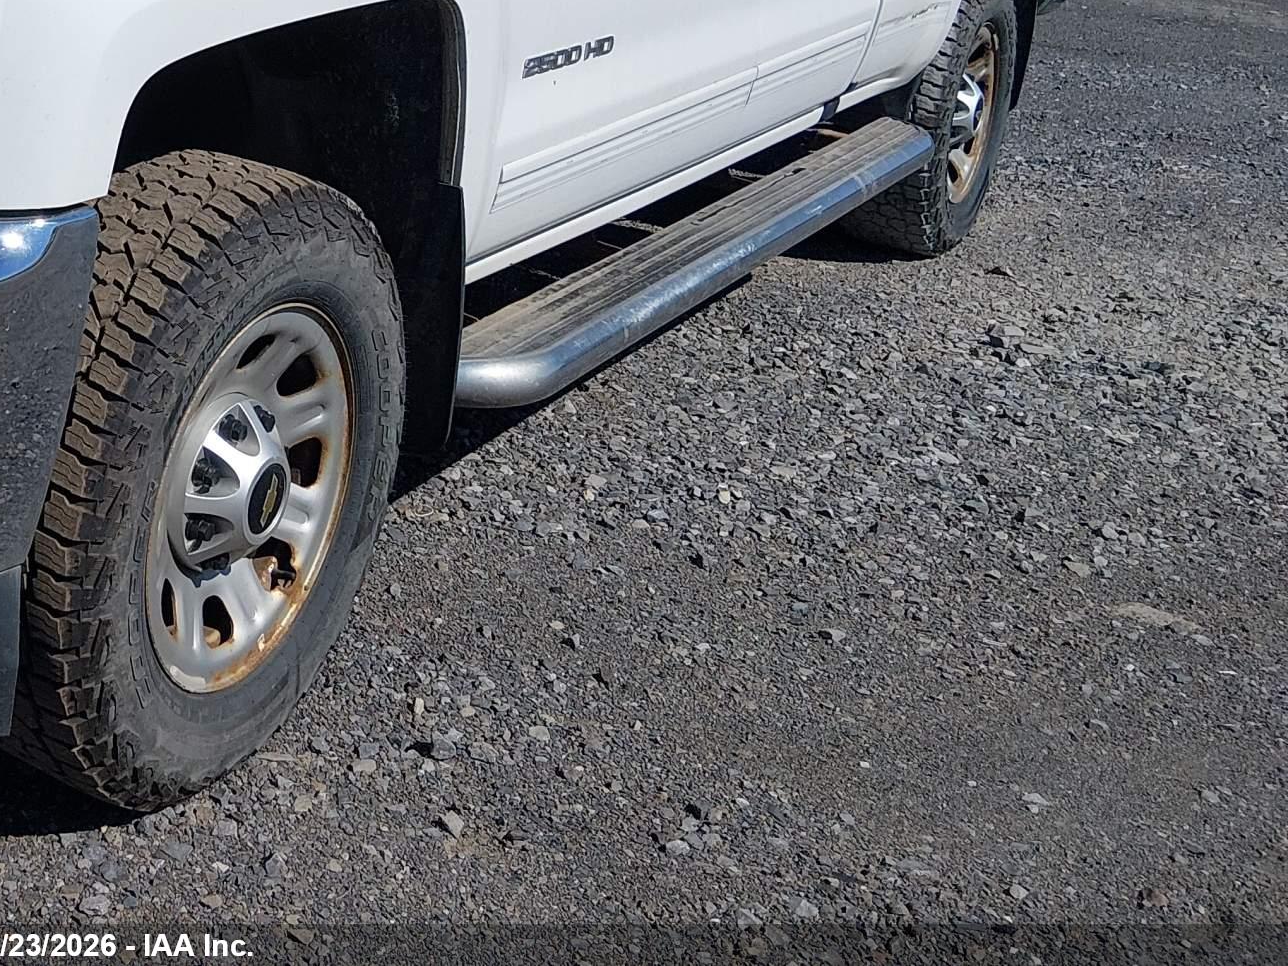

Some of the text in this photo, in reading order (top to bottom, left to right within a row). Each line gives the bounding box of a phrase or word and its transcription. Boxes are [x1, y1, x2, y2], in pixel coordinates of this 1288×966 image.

[522, 35, 615, 79] 2500 HD
[369, 330, 393, 522] COOPER
